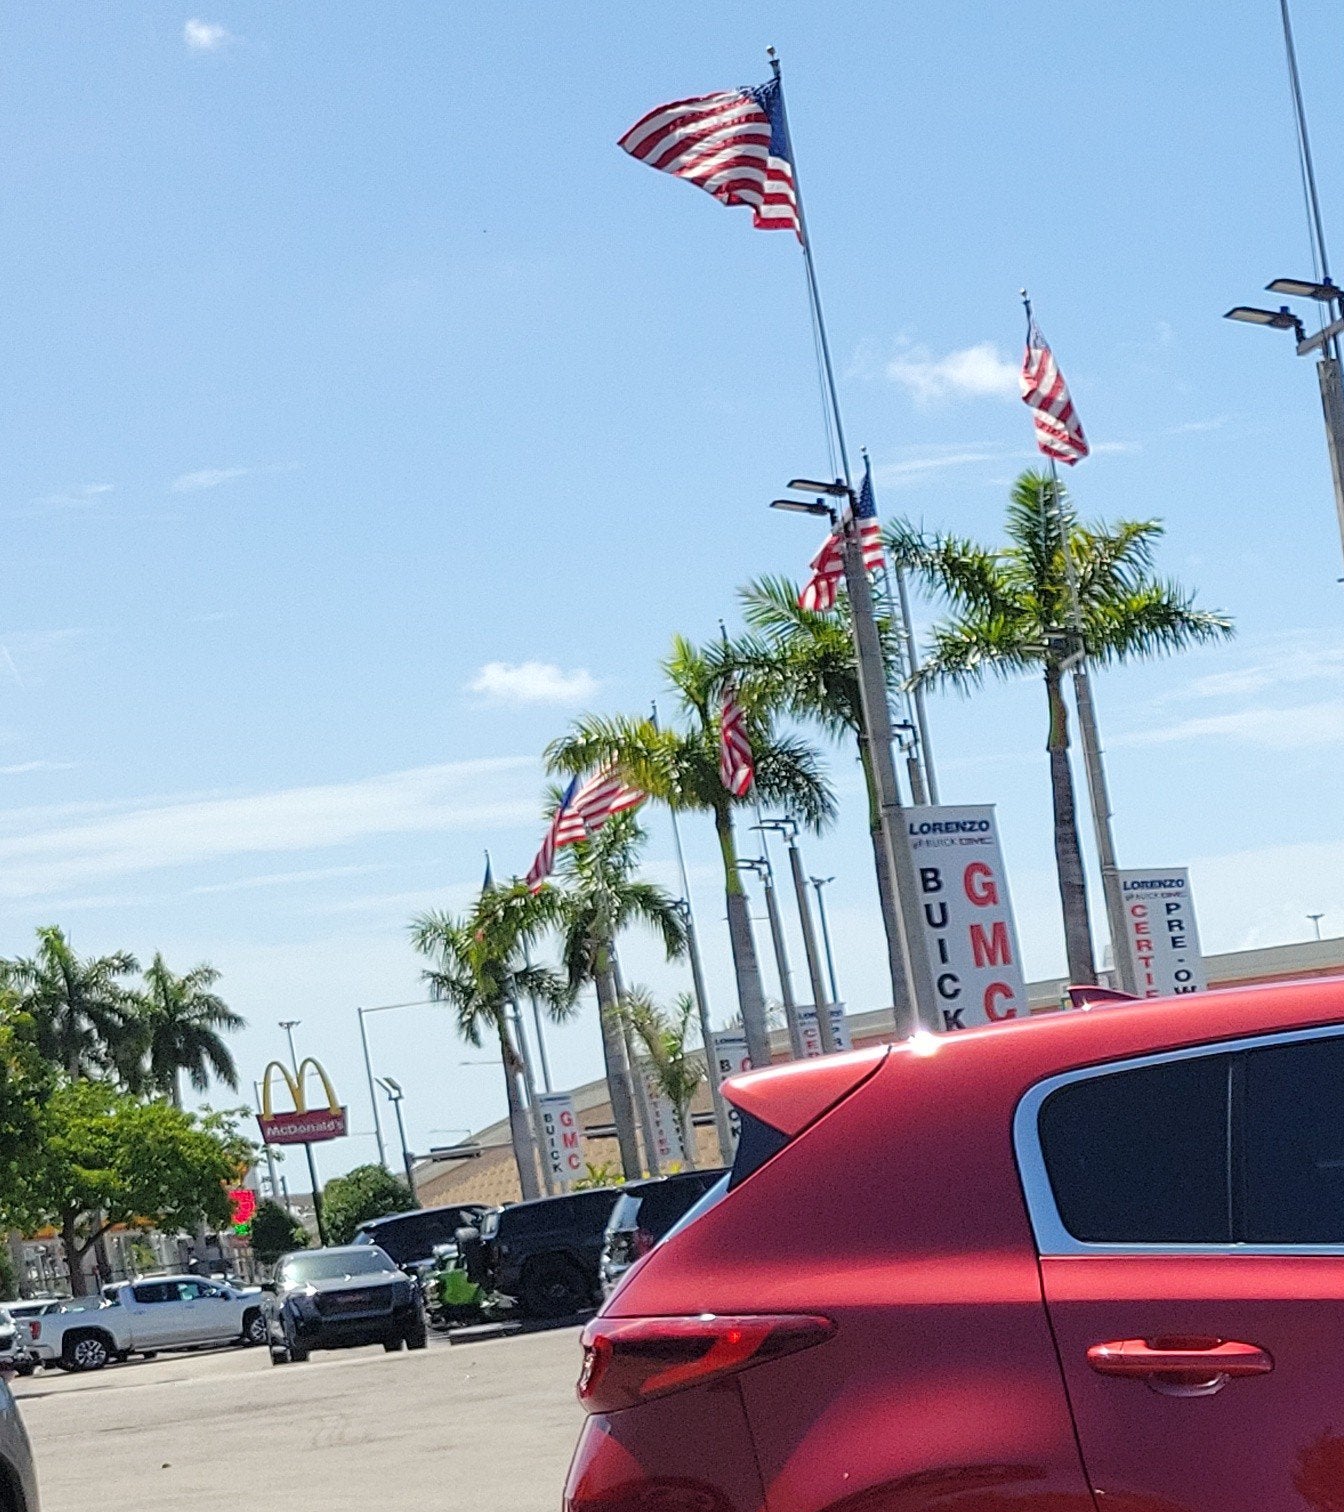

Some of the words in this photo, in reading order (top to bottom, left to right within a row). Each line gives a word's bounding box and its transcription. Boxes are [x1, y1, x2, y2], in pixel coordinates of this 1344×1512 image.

[908, 819, 990, 836] LORENZO
[1123, 879, 1185, 891] LORENZO
[963, 862, 1018, 1022] GMC
[267, 1118, 344, 1136] McDonald's
